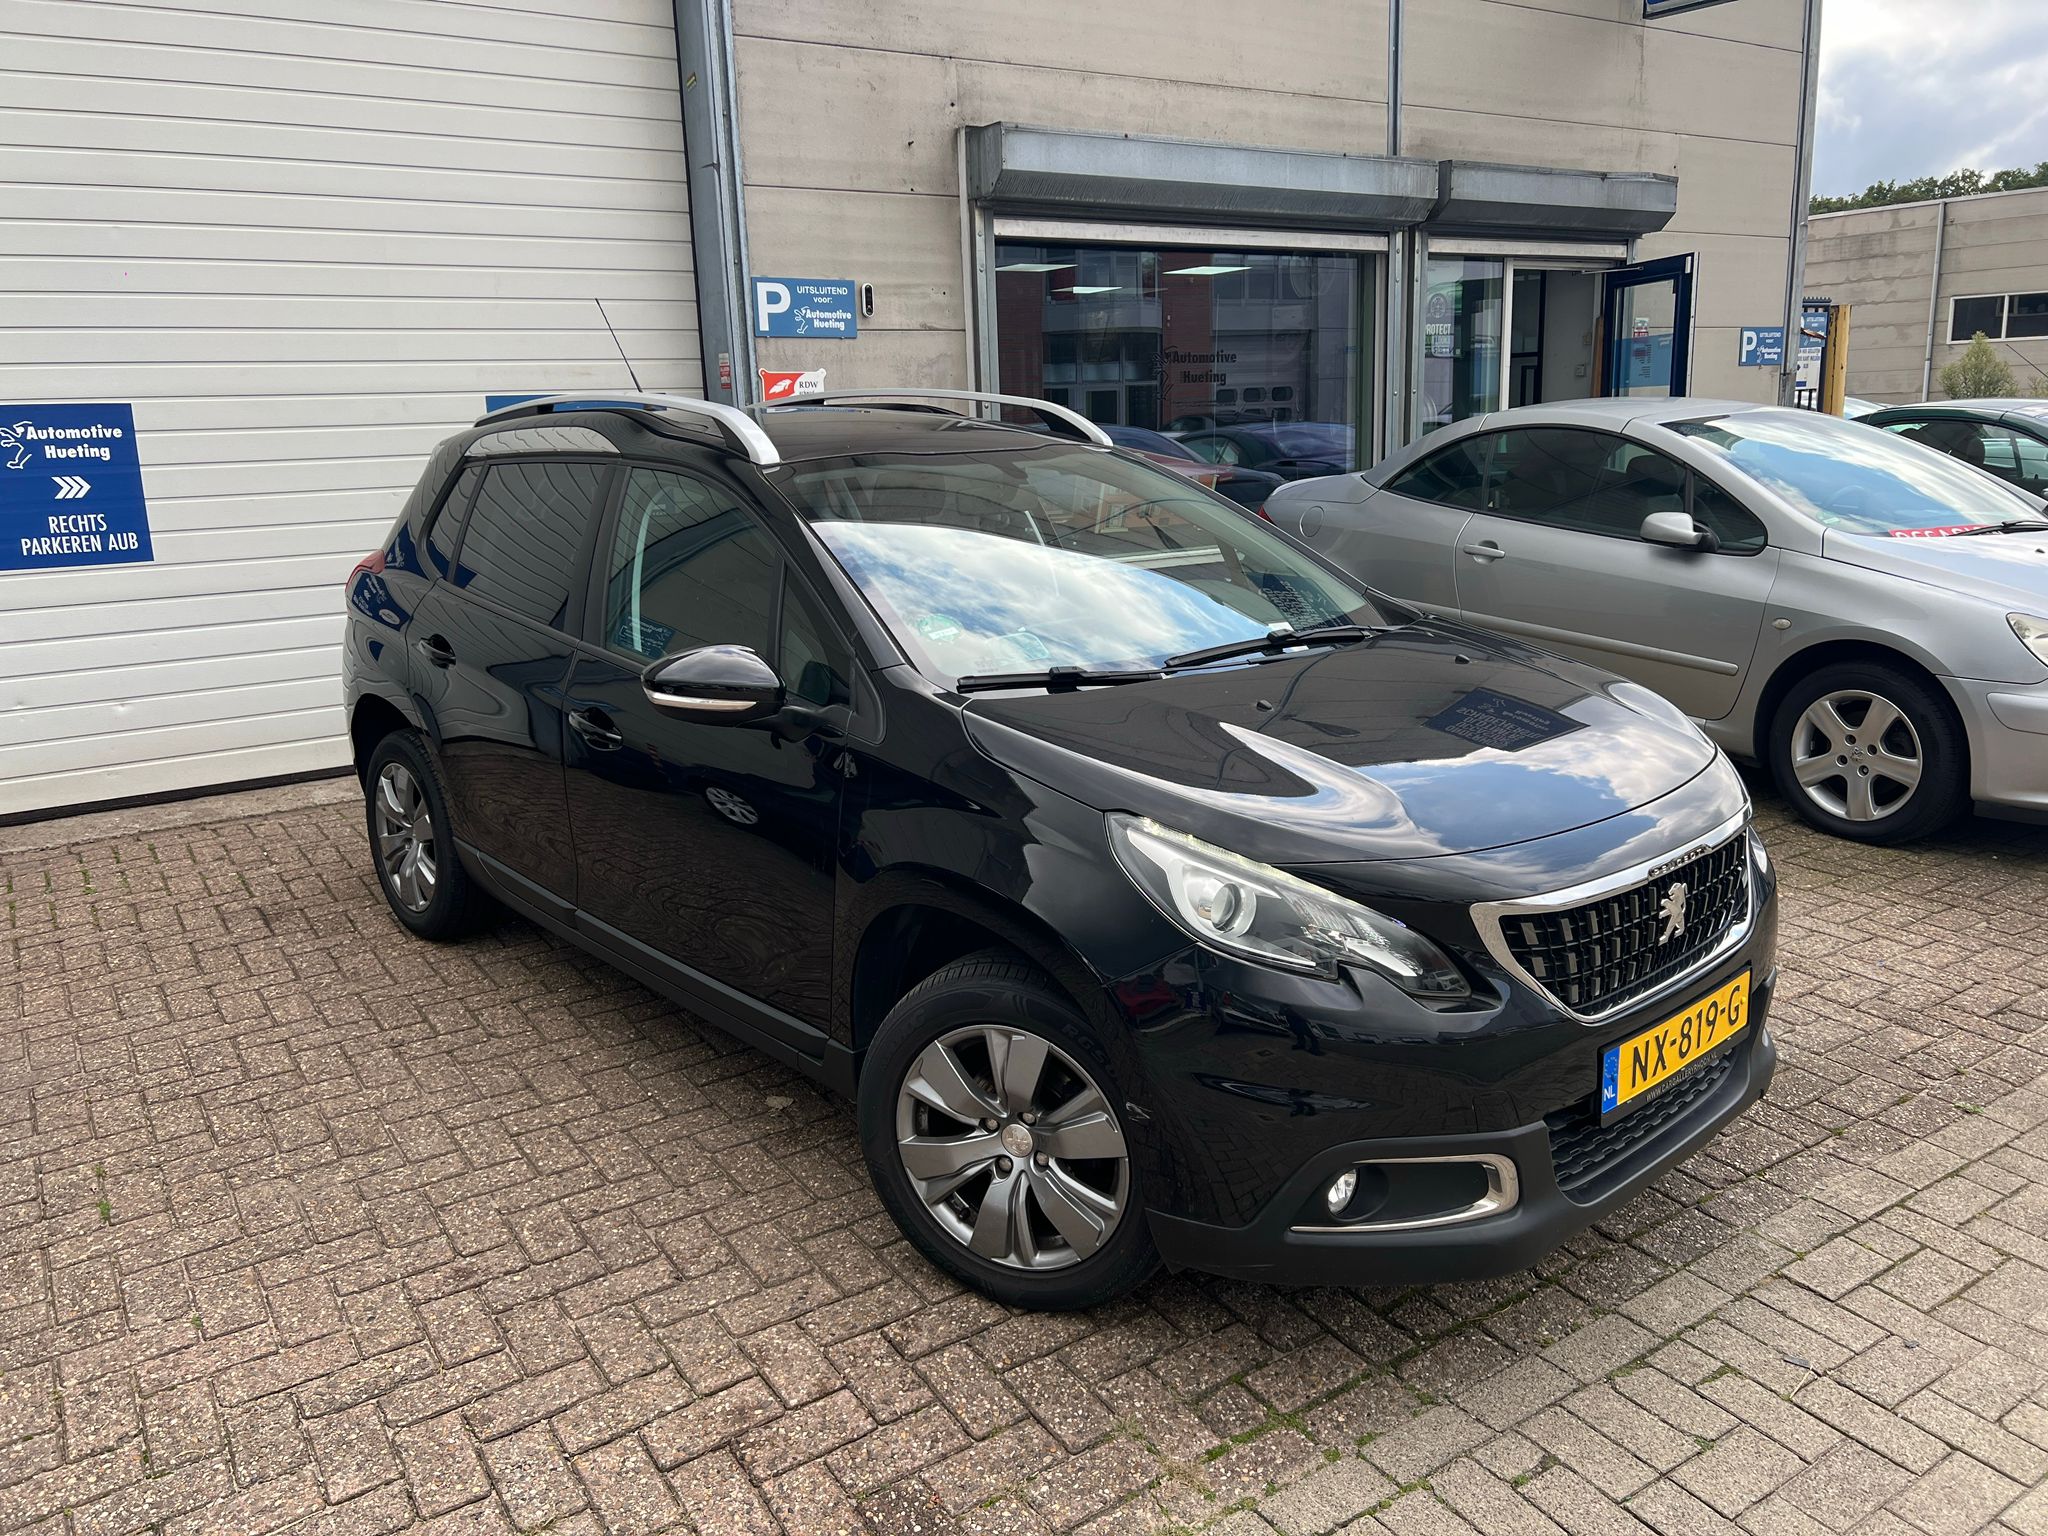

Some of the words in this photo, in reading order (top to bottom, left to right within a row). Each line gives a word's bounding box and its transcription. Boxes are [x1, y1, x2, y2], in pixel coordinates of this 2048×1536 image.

[796, 285, 848, 295] UITSLUITEND
[756, 281, 791, 332] P
[812, 296, 833, 304] voor:
[805, 309, 852, 319] Automotive
[813, 319, 845, 331] Hueting
[1426, 323, 1451, 335] ROTECT
[1742, 331, 1757, 362] P
[1169, 349, 1237, 364] Automotive
[799, 381, 818, 389] RDW
[1183, 369, 1227, 386] Hueting
[26, 424, 122, 440] Automotive
[44, 443, 111, 461] Hueting
[48, 513, 108, 534] RECHTS
[20, 534, 102, 556] PARKEREN
[108, 532, 139, 551] AUB
[1631, 984, 1741, 1089] NX-819-G
[1603, 1084, 1616, 1099] NL
